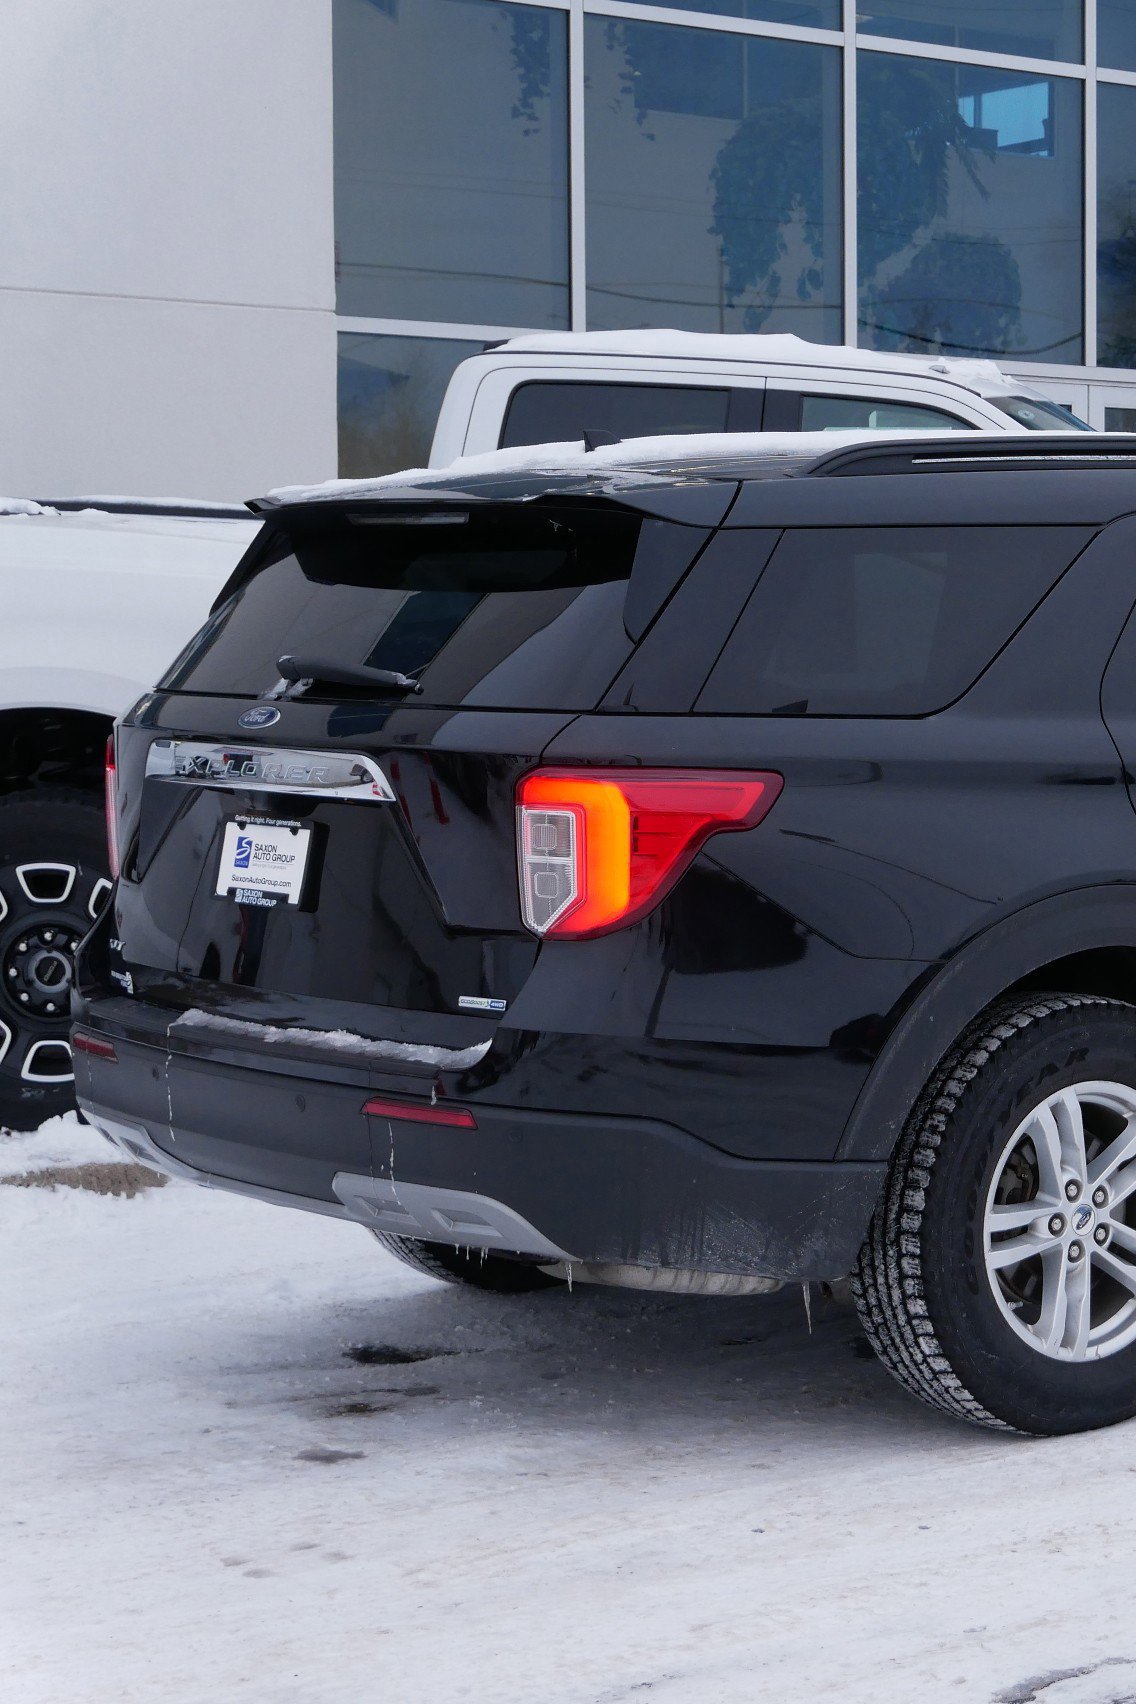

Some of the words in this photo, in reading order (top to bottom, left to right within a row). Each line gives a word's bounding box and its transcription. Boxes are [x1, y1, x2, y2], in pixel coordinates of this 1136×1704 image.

[235, 814, 250, 823] Getting
[265, 818, 276, 826] Four
[254, 843, 278, 853] SAXON
[252, 852, 272, 861] AUTO
[271, 854, 296, 863] GROUP
[231, 874, 292, 888] SaxonAutoGroup.com
[243, 889, 263, 897] SAXON
[241, 896, 258, 904] AUTO
[257, 897, 277, 907] GROUP
